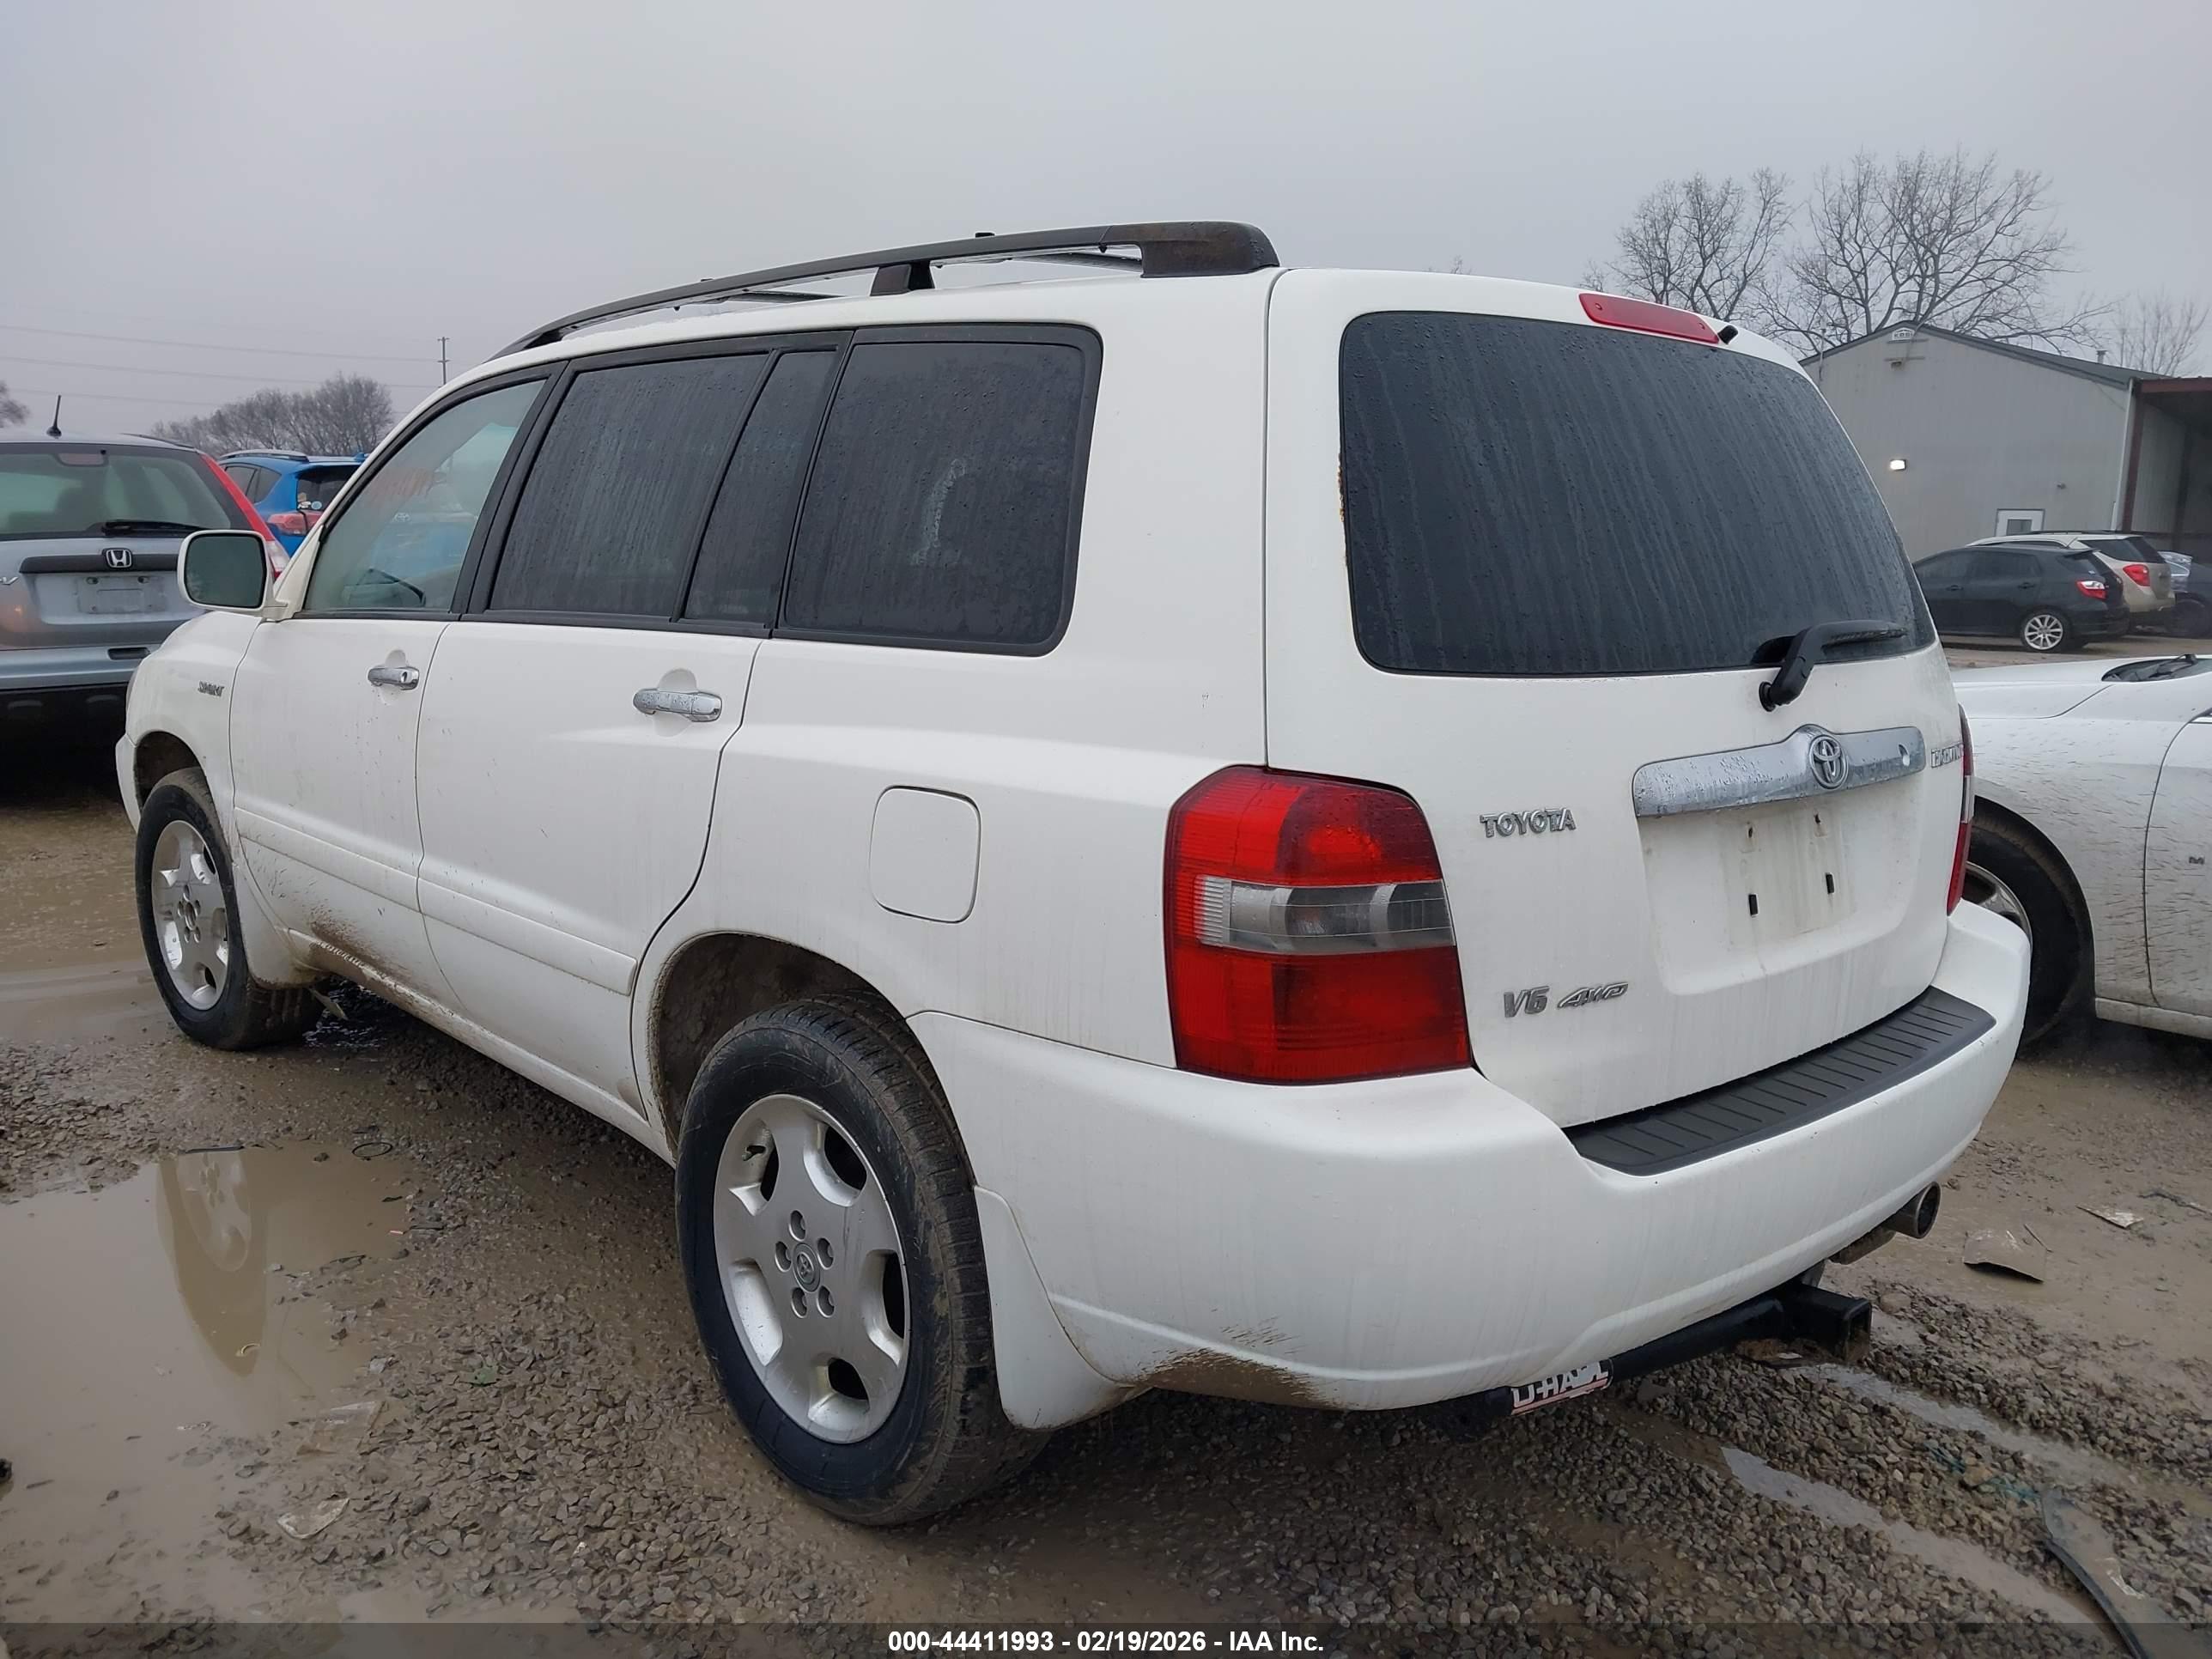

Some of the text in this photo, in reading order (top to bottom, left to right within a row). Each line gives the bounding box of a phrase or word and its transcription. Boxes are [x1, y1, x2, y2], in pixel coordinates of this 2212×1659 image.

[1480, 807, 1577, 838] TOYOTA
[1504, 981, 1629, 1018] V6 4WD
